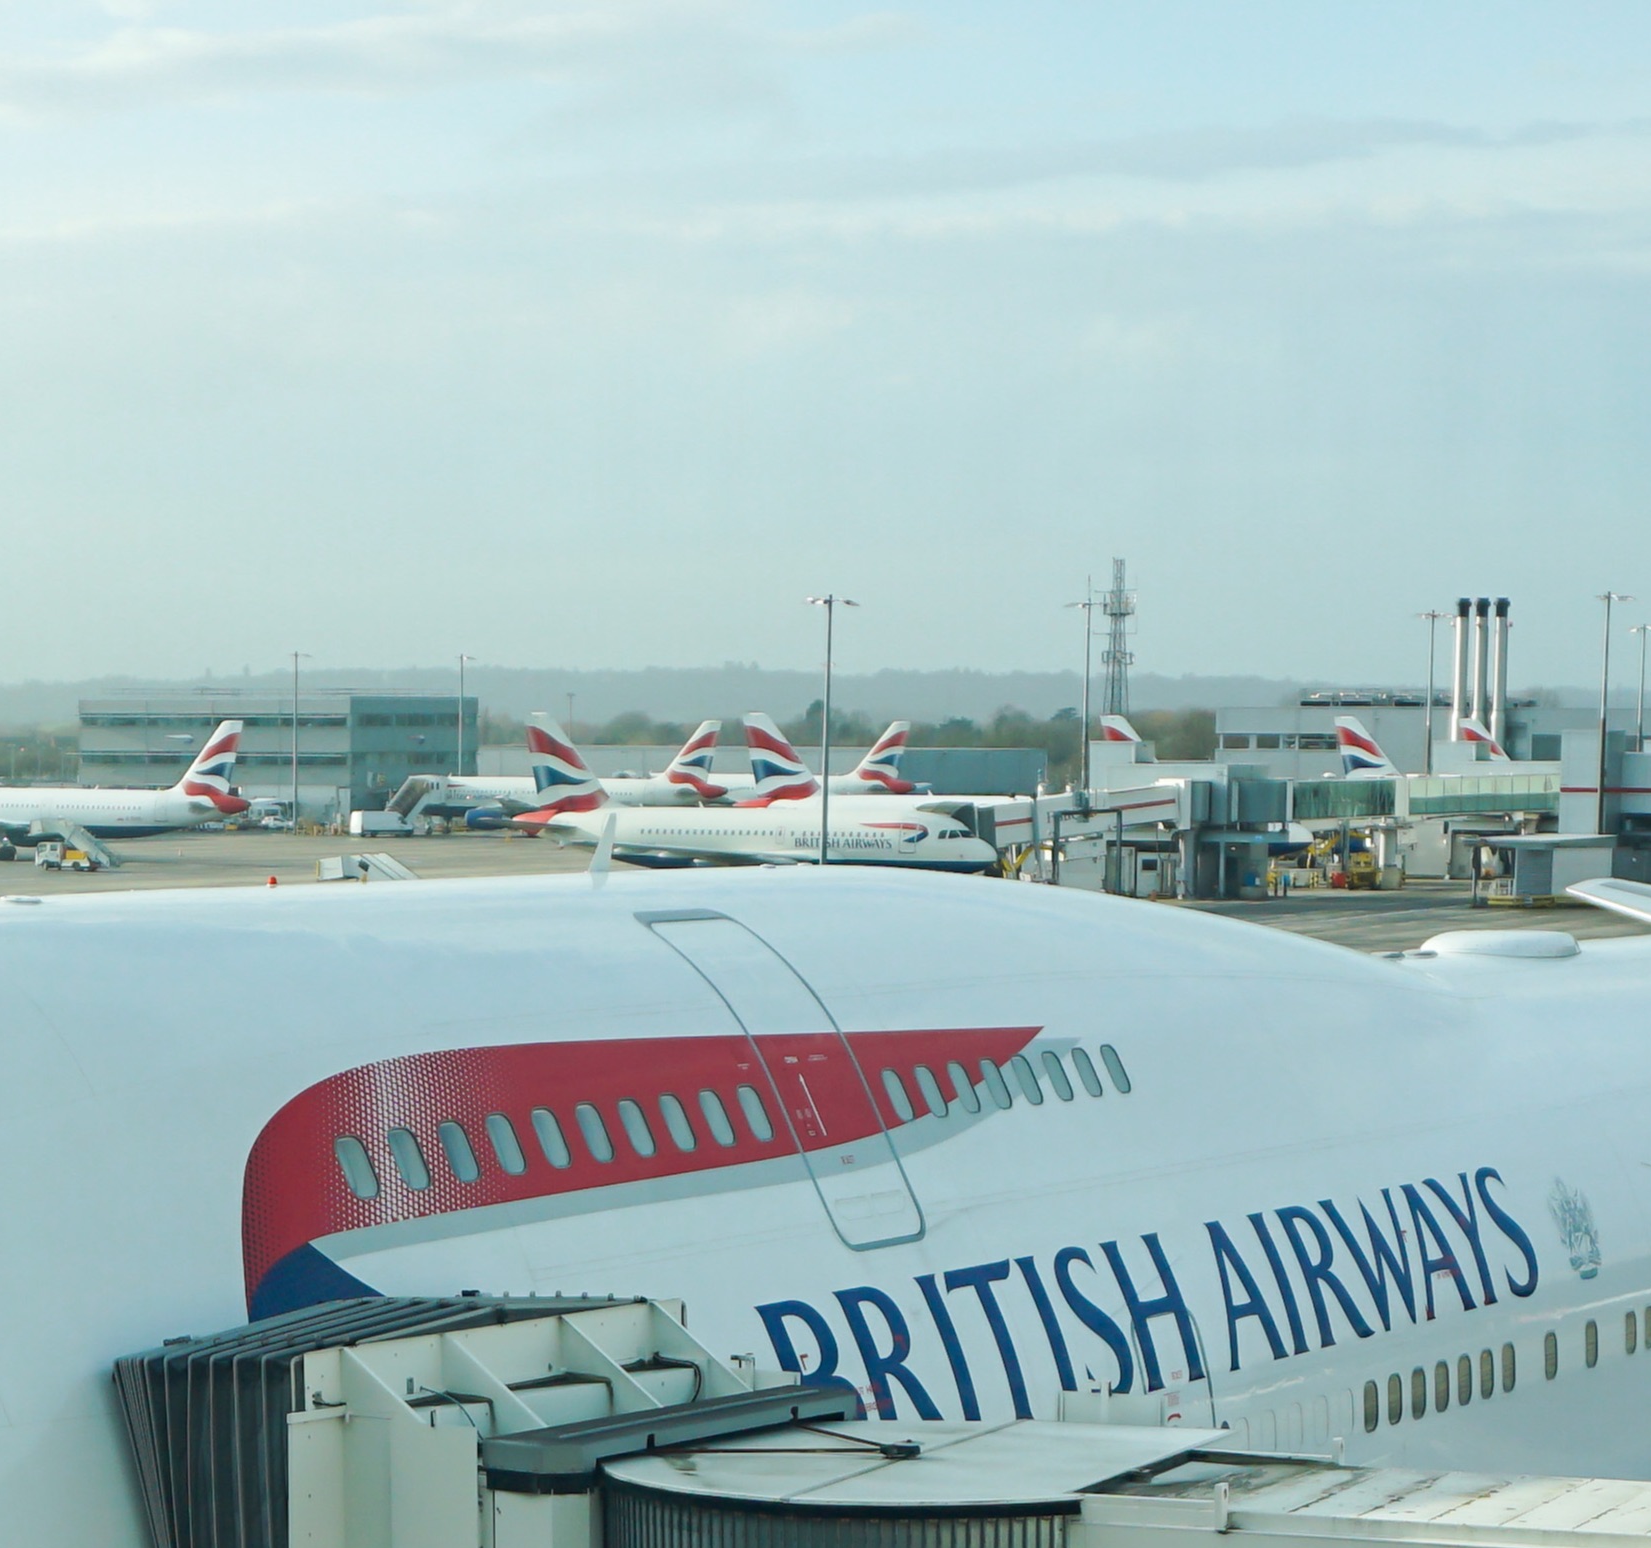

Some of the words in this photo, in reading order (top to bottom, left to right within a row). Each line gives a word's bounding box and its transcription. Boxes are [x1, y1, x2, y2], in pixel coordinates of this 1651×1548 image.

[794, 837, 840, 848] BRITSH
[842, 838, 892, 849] AIRWAYS
[755, 1233, 1205, 1421] BRITISH
[1205, 1166, 1539, 1371] AIRWAYS
